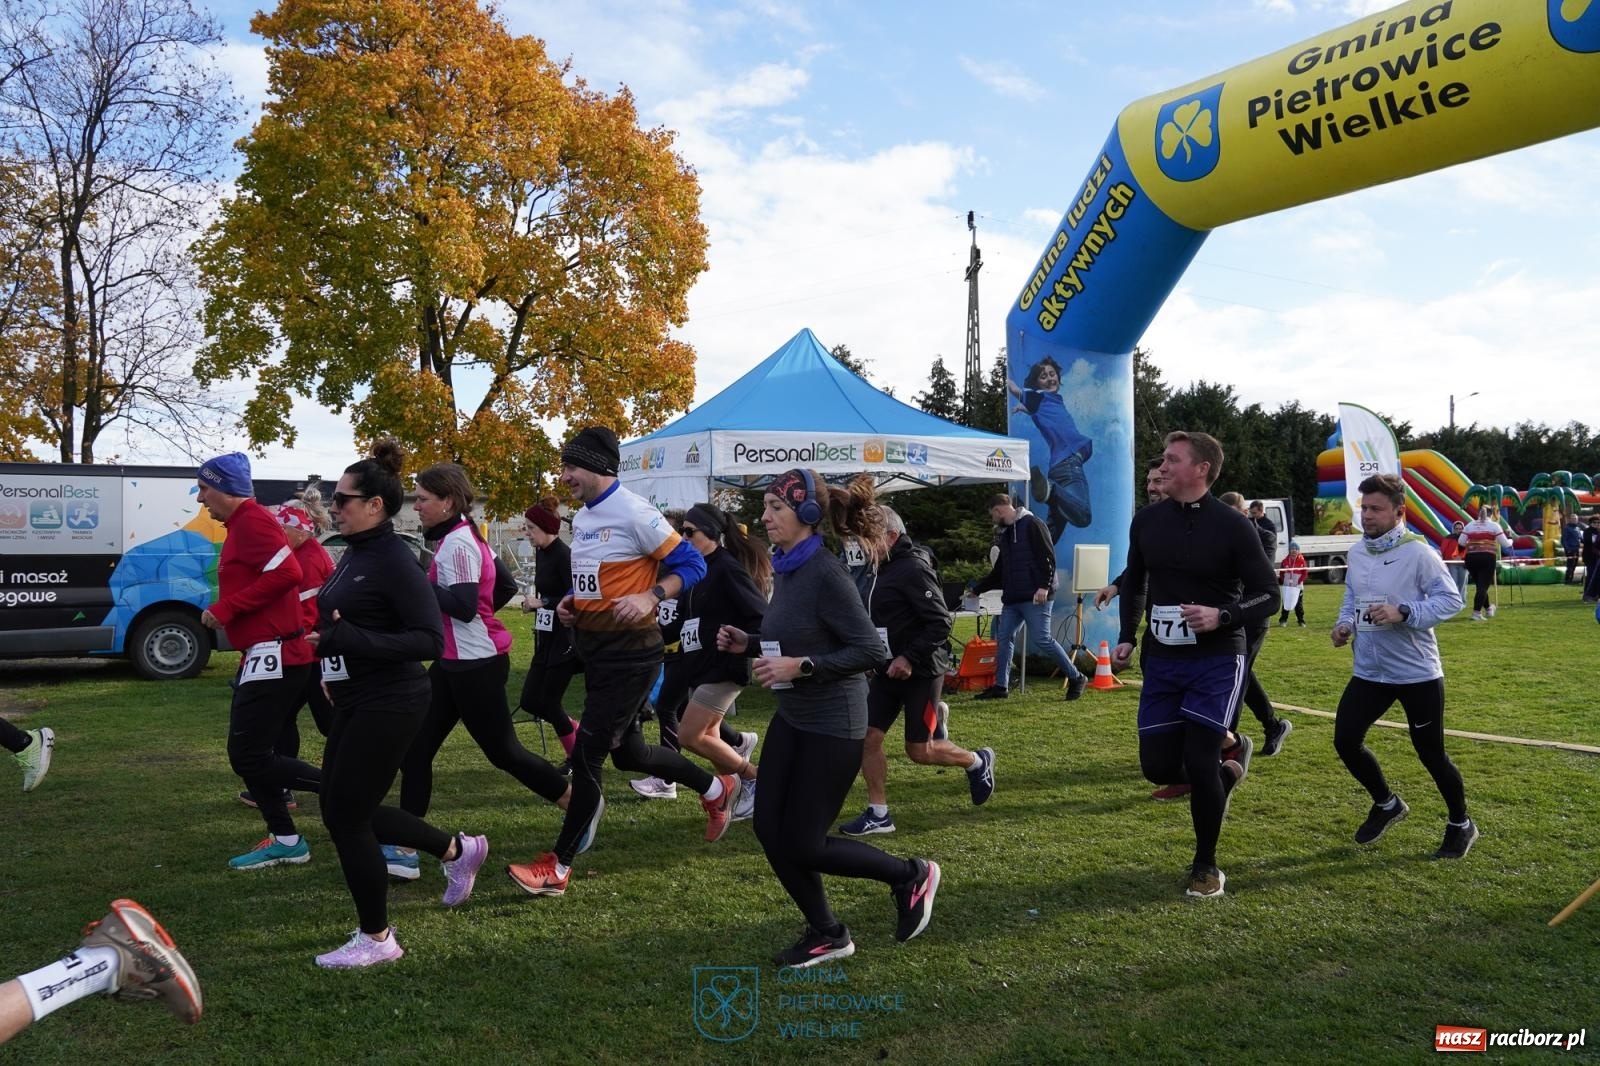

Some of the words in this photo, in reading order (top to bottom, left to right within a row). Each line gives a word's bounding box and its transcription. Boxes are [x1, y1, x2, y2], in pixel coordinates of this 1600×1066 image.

[1287, 1, 1451, 75] Gmina
[1248, 21, 1502, 129] Pietrowice
[1277, 81, 1470, 156] Wielkie
[1020, 230, 1069, 311] Gmina
[1067, 153, 1113, 231] ludzi
[1038, 181, 1136, 331] aktywnych
[734, 442, 857, 463] PersonalBest
[986, 458, 1012, 469] MITKO
[11, 570, 68, 583] masaż
[573, 574, 597, 592] 768
[1356, 609, 1373, 624] 74
[681, 629, 698, 646] 734
[1152, 619, 1189, 637] 771
